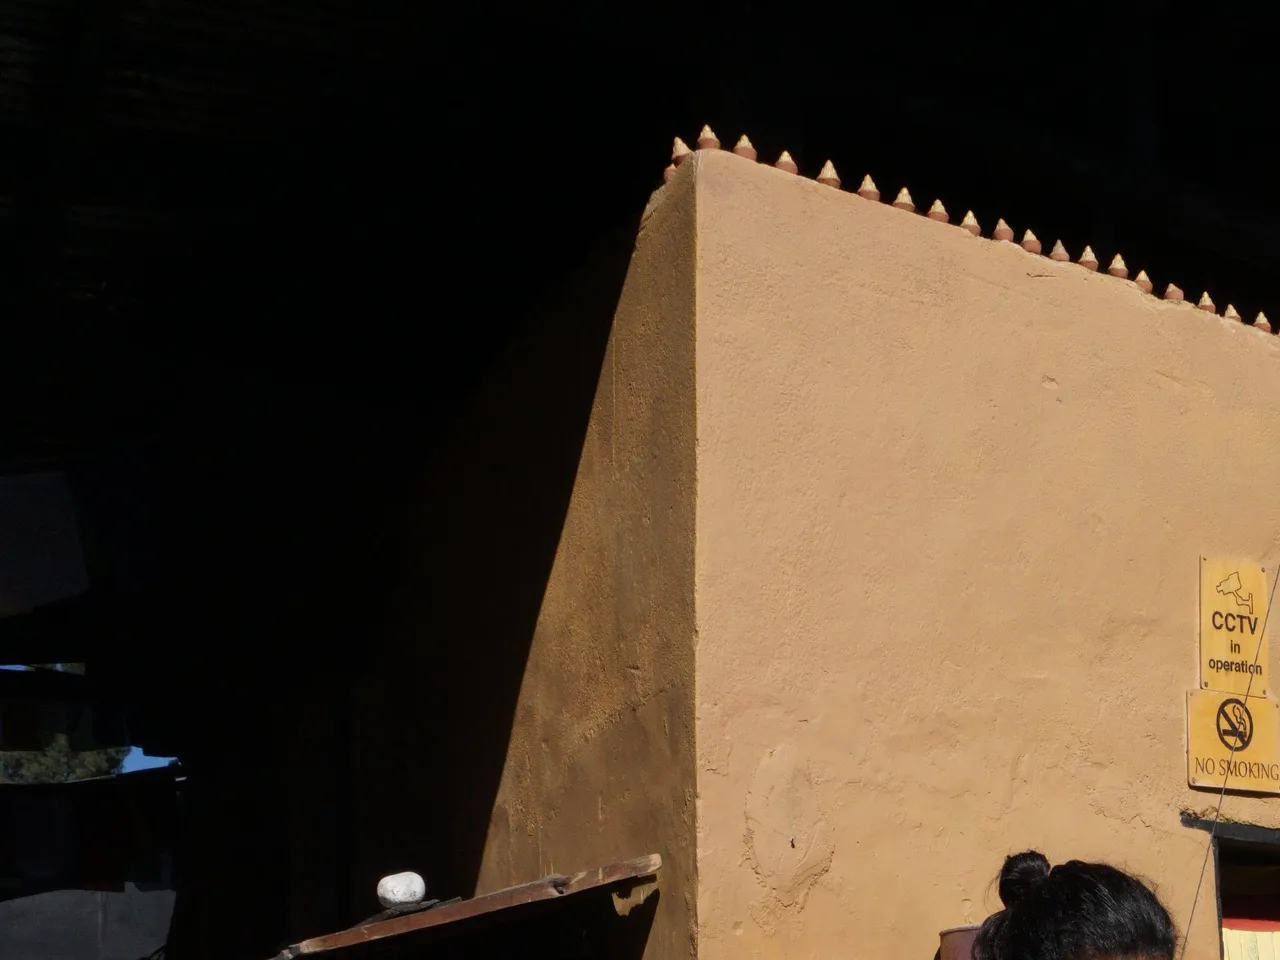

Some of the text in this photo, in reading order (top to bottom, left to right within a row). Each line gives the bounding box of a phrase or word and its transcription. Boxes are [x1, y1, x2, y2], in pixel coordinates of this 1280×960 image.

[1212, 611, 1259, 635] CCTV
[1230, 640, 1241, 654] in
[1208, 657, 1263, 675] operation
[1194, 757, 1280, 781] NO SMOKING
